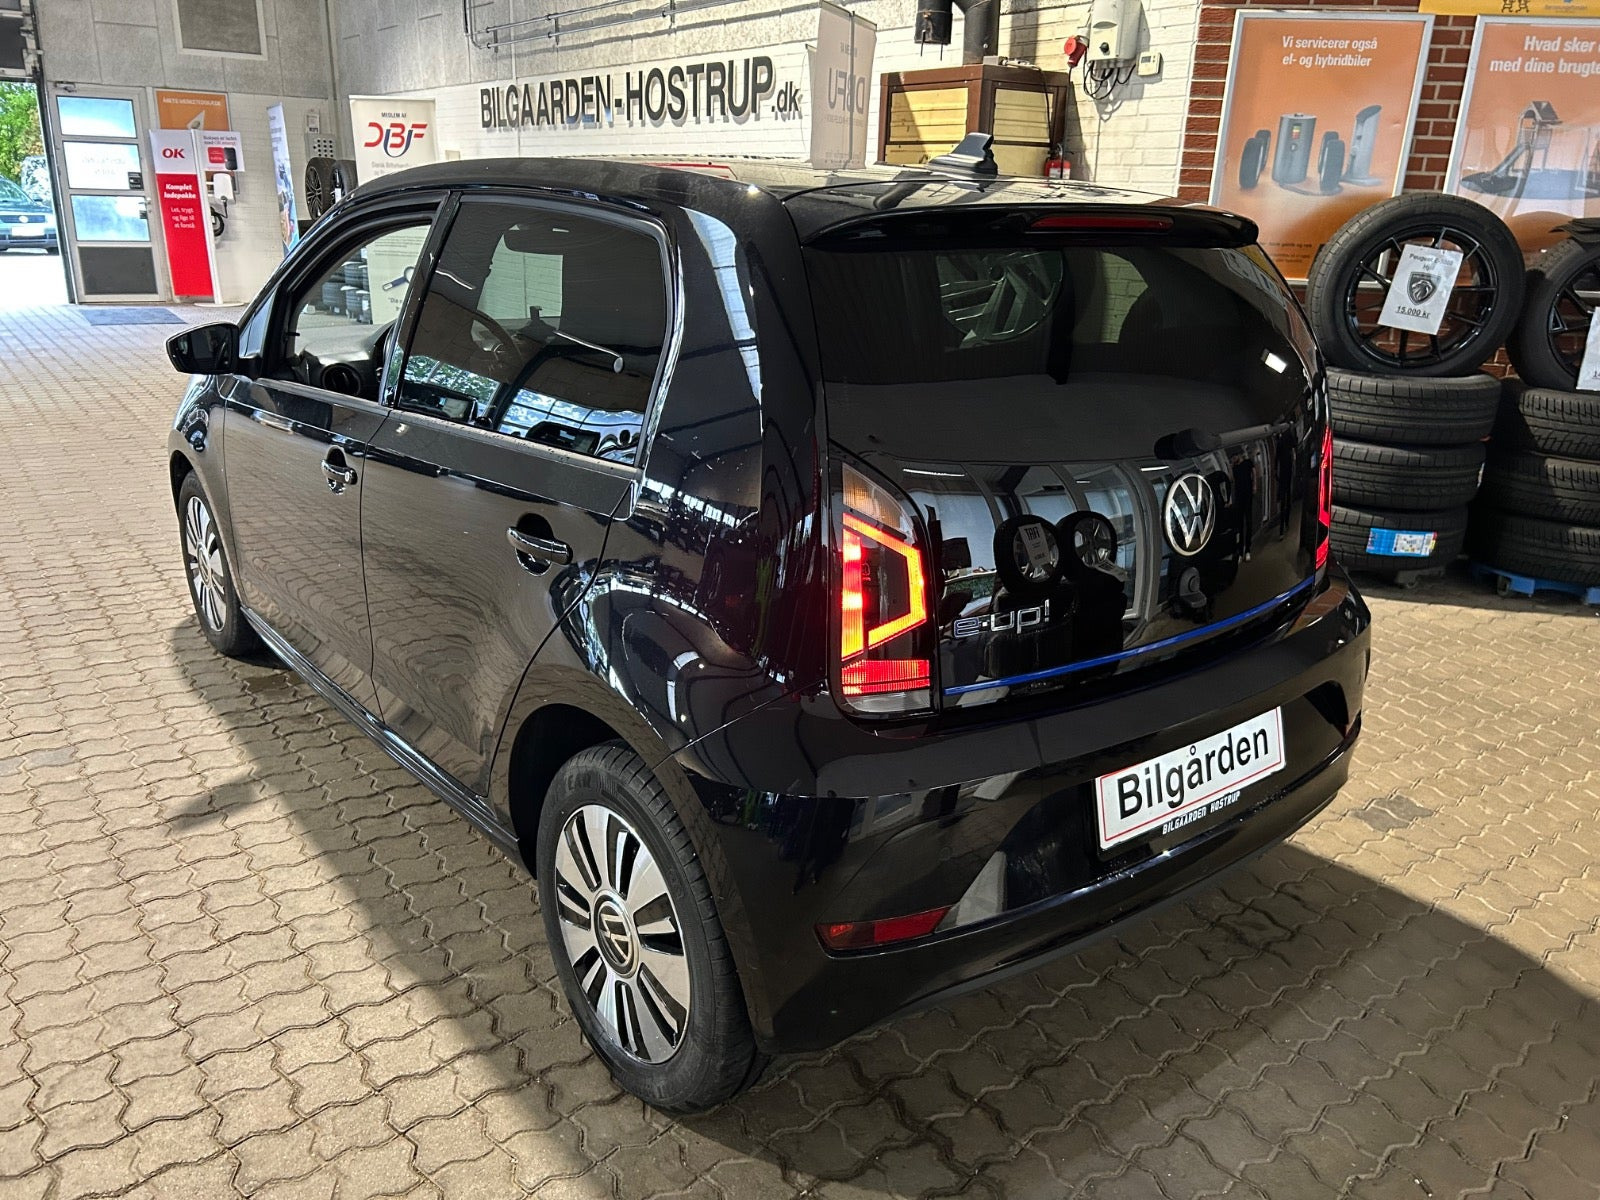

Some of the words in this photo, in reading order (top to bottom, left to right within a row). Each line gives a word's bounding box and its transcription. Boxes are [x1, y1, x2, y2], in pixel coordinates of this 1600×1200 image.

[1282, 35, 1294, 48] Vi
[1295, 36, 1350, 49] servicerer
[1351, 36, 1378, 52] også
[1523, 35, 1562, 52] Hvad
[1563, 36, 1596, 53] sker
[1282, 53, 1297, 65] el-
[1299, 55, 1313, 68] og
[1314, 53, 1372, 69] hybridbiler
[1489, 57, 1522, 72] med
[1524, 57, 1555, 73] dine
[162, 148, 185, 159] OK
[165, 183, 192, 191] Komplet
[163, 192, 196, 200] ladepakke
[1396, 305, 1421, 317] 15.000
[1116, 728, 1269, 820] Bilgården
[1162, 806, 1207, 835] BILGAARDEN
[1210, 790, 1241, 814] HOSTRUP
